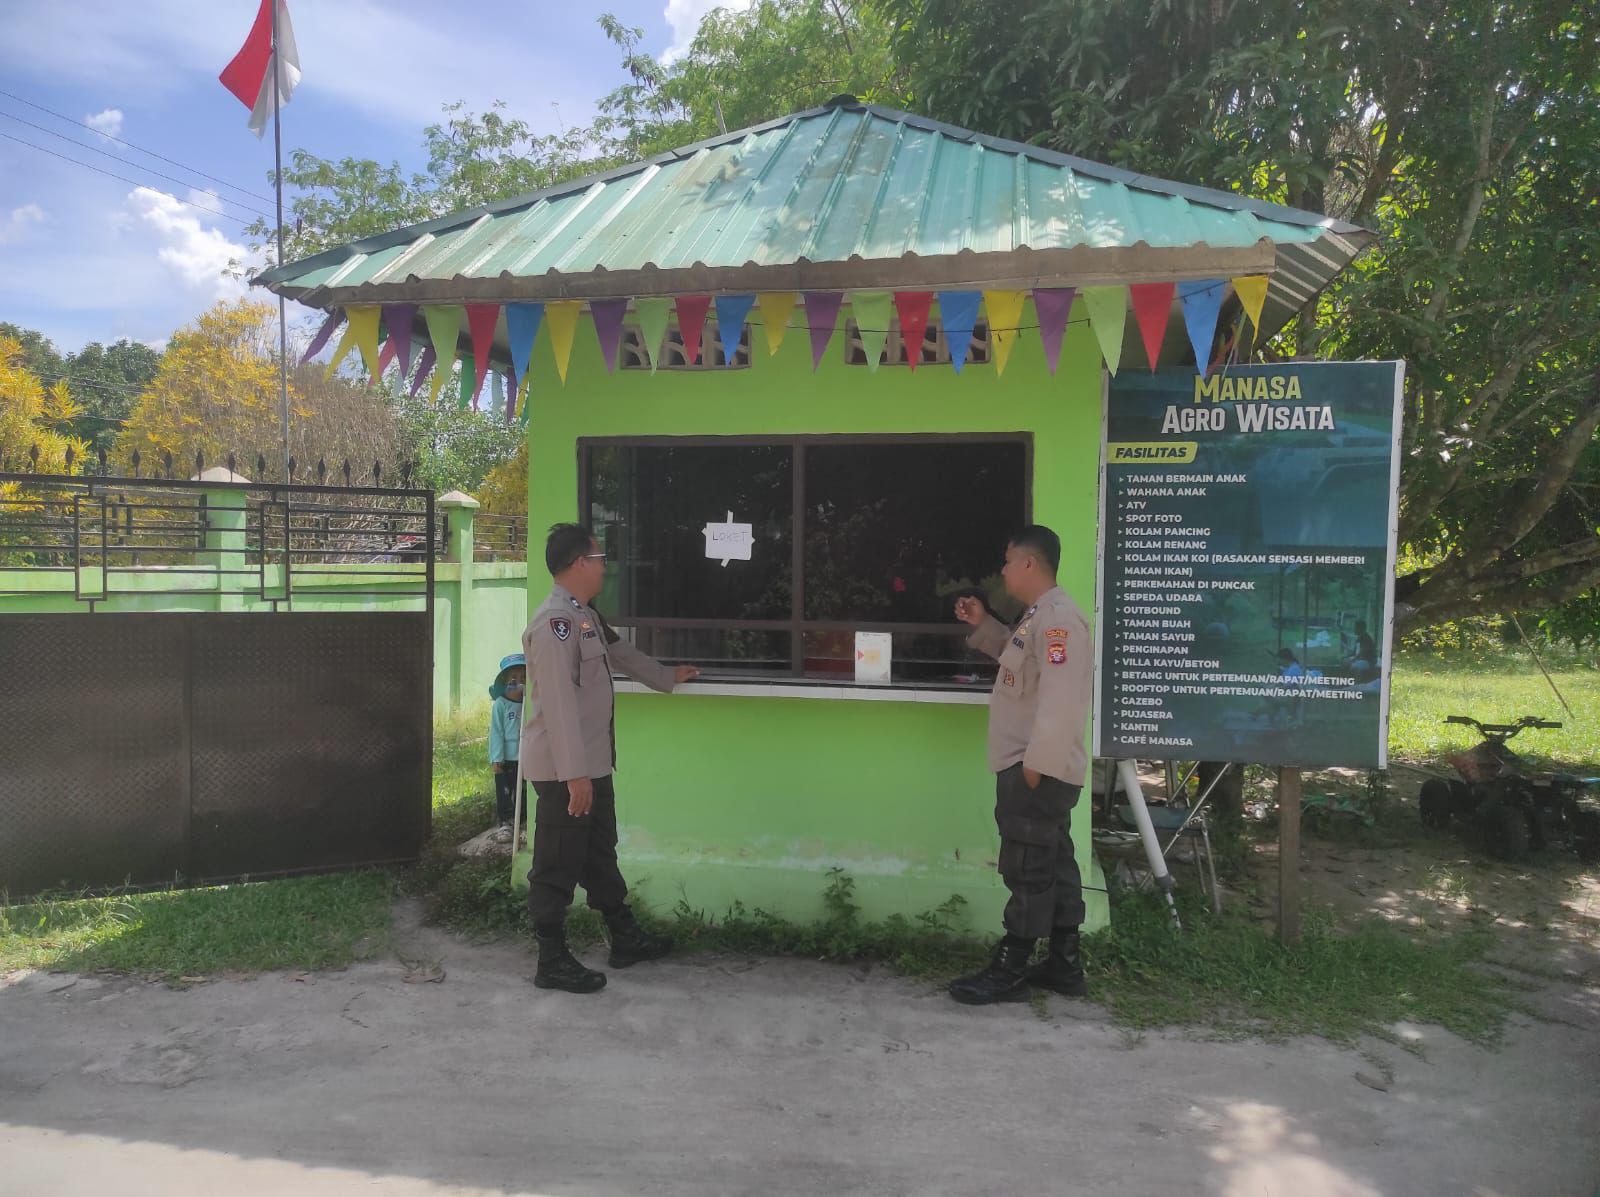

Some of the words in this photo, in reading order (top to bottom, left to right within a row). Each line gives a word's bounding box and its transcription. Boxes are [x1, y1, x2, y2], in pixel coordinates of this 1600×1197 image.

[1194, 375, 1301, 403] MANASA
[1161, 405, 1225, 434] AGRO
[1236, 403, 1335, 433] WISATA
[1115, 447, 1187, 458] FASILITAS
[1127, 474, 1163, 483] TAMAN
[1166, 474, 1214, 483] BERMAIN
[1216, 474, 1246, 482] ANAK
[1127, 488, 1174, 496] WAHANA
[1176, 487, 1207, 496] ANAK
[1126, 501, 1146, 510] ATV
[1126, 514, 1152, 523] SPOT
[1155, 514, 1182, 523] FOTO
[1125, 527, 1162, 536] KOLAM
[1165, 528, 1210, 536] PANCING
[1125, 541, 1161, 549] KOLAM
[1164, 541, 1207, 549] RENANG
[1125, 554, 1161, 562] KOLAM
[1163, 554, 1188, 563] IKAN
[1191, 554, 1209, 563] KOI
[1212, 555, 1266, 565] (RASAKAN
[1268, 555, 1313, 564] SENSASI
[1315, 556, 1365, 565] MEMBERI
[1125, 567, 1162, 576] MAKAN
[1164, 567, 1193, 577] IKAN)
[1124, 580, 1196, 589] PERKEMAHAN
[1198, 581, 1209, 589] DI
[1211, 581, 1255, 590] PUNCAK
[1123, 593, 1164, 602] SEPEDA
[1166, 593, 1202, 602] UDARA
[1123, 606, 1181, 615] OUTBOUND
[1123, 619, 1160, 628] TAMAN
[1162, 620, 1191, 628] BUAH
[1123, 632, 1160, 641] TAMAN
[1162, 632, 1195, 642] SAYUR
[1123, 645, 1188, 655] PENGINAPAN
[1123, 658, 1151, 667] VILLA
[1153, 658, 1219, 669] KAYU/BETON
[1122, 671, 1162, 680] BETANG
[1165, 671, 1199, 681] UNTUK
[1202, 673, 1355, 686] PERTEMUAN/RAPAT/MEETING
[1122, 684, 1170, 693] ROOFTOP
[1173, 685, 1207, 695] UNTUK
[1210, 686, 1363, 700] PERTEMUAN/RAPAT/MEETING
[1121, 697, 1163, 706] GAZEBO
[1121, 710, 1173, 720] PUJASERA
[1121, 723, 1158, 732] KANTIN
[1120, 734, 1147, 745] CAFÉ
[1149, 735, 1193, 746] MANASA
